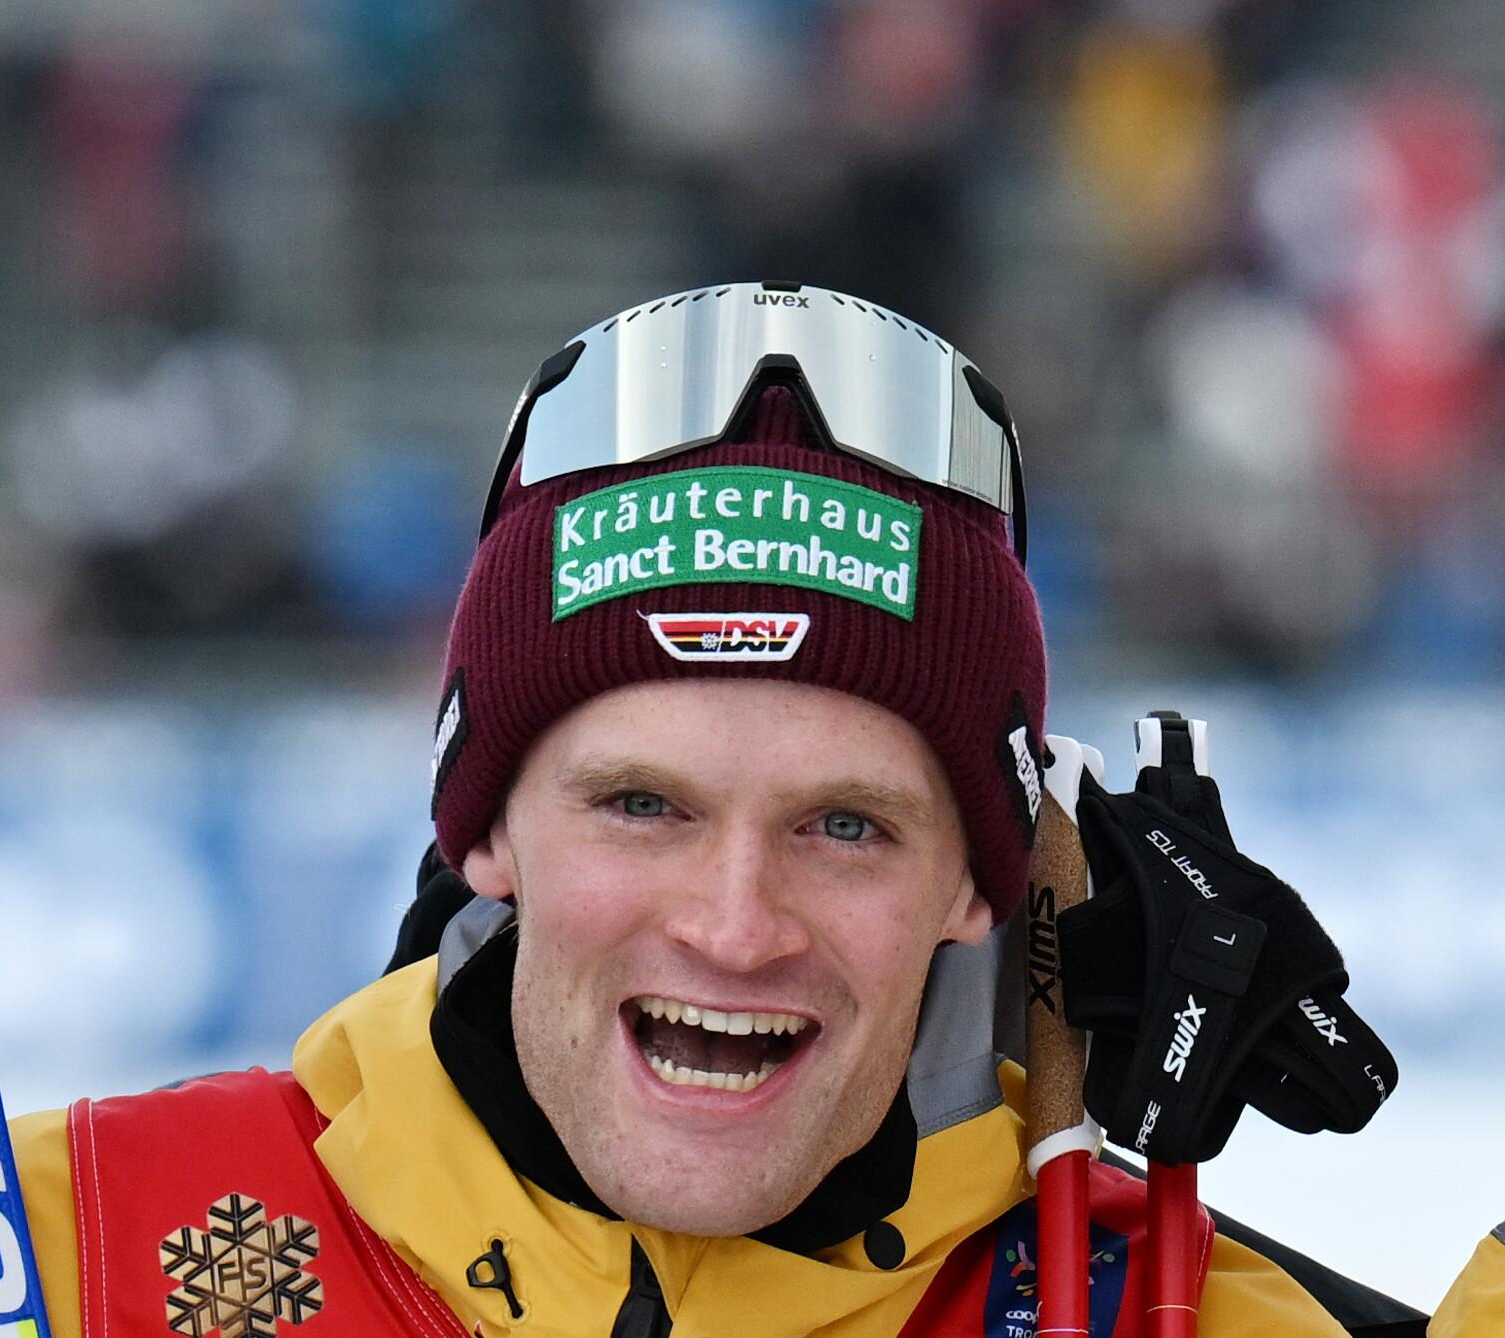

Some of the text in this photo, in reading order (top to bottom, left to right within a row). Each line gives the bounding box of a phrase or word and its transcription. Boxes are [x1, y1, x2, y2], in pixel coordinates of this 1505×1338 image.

[752, 293, 810, 310] uvex
[560, 480, 912, 553] Kräuterhaus
[557, 528, 911, 606] Sanct Bernhard
[724, 620, 793, 651] DSV
[1146, 828, 1219, 901] PROFIT TCS
[1162, 993, 1207, 1083] swix
